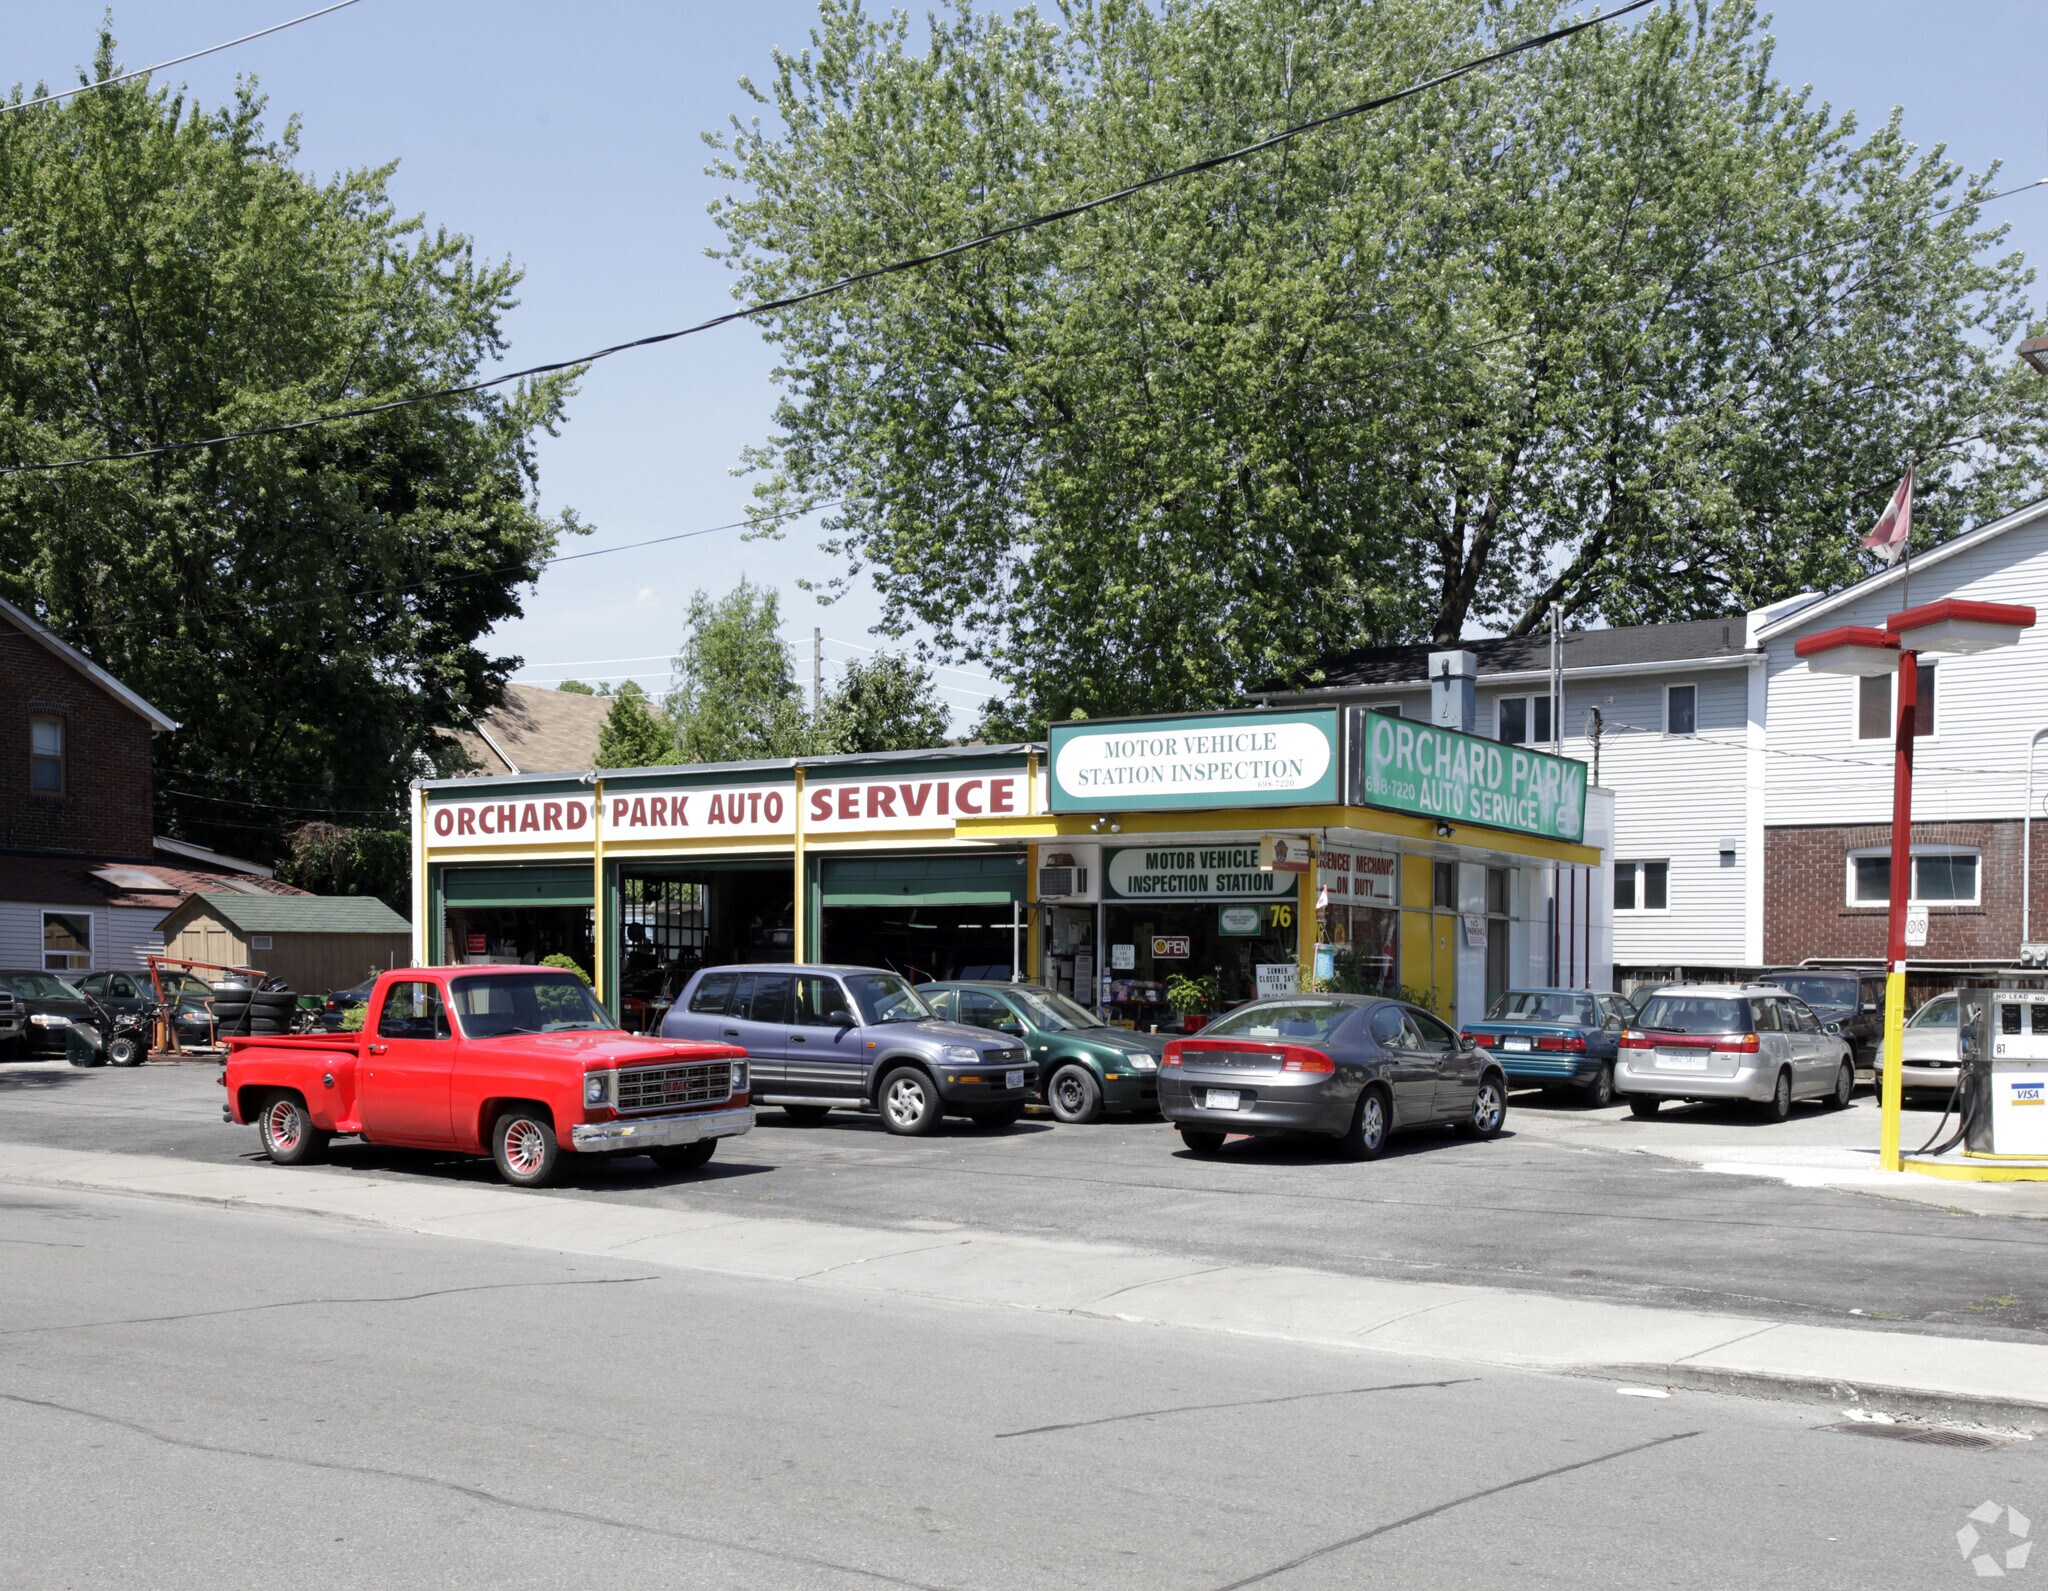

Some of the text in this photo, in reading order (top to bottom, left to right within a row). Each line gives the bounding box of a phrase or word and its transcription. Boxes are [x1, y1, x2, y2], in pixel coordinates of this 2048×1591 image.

[1104, 732, 1277, 759] MOTOR VEHICLE
[1078, 759, 1303, 786] STATION INSPECTION
[1373, 719, 1578, 805] ORCHARD PARK
[434, 778, 1015, 837] ORCHARD PARK AUTO SERVICE
[1420, 777, 1464, 815] AUTO
[1470, 788, 1538, 829] SERVICE
[1145, 849, 1258, 870] MOTOR VEHICLE
[1355, 855, 1394, 876] MECHANIC
[1128, 873, 1274, 893] INSPECTION STATION
[1336, 876, 1374, 897] ON DUTY
[1270, 905, 1291, 928] 76
[1470, 919, 1479, 928] NO
[1466, 926, 1485, 936] PARKING
[1154, 939, 1188, 954] OPEN
[1259, 975, 1280, 983] CLOSED
[1996, 1043, 2006, 1054] 87
[2017, 1089, 2039, 1099] VISA
